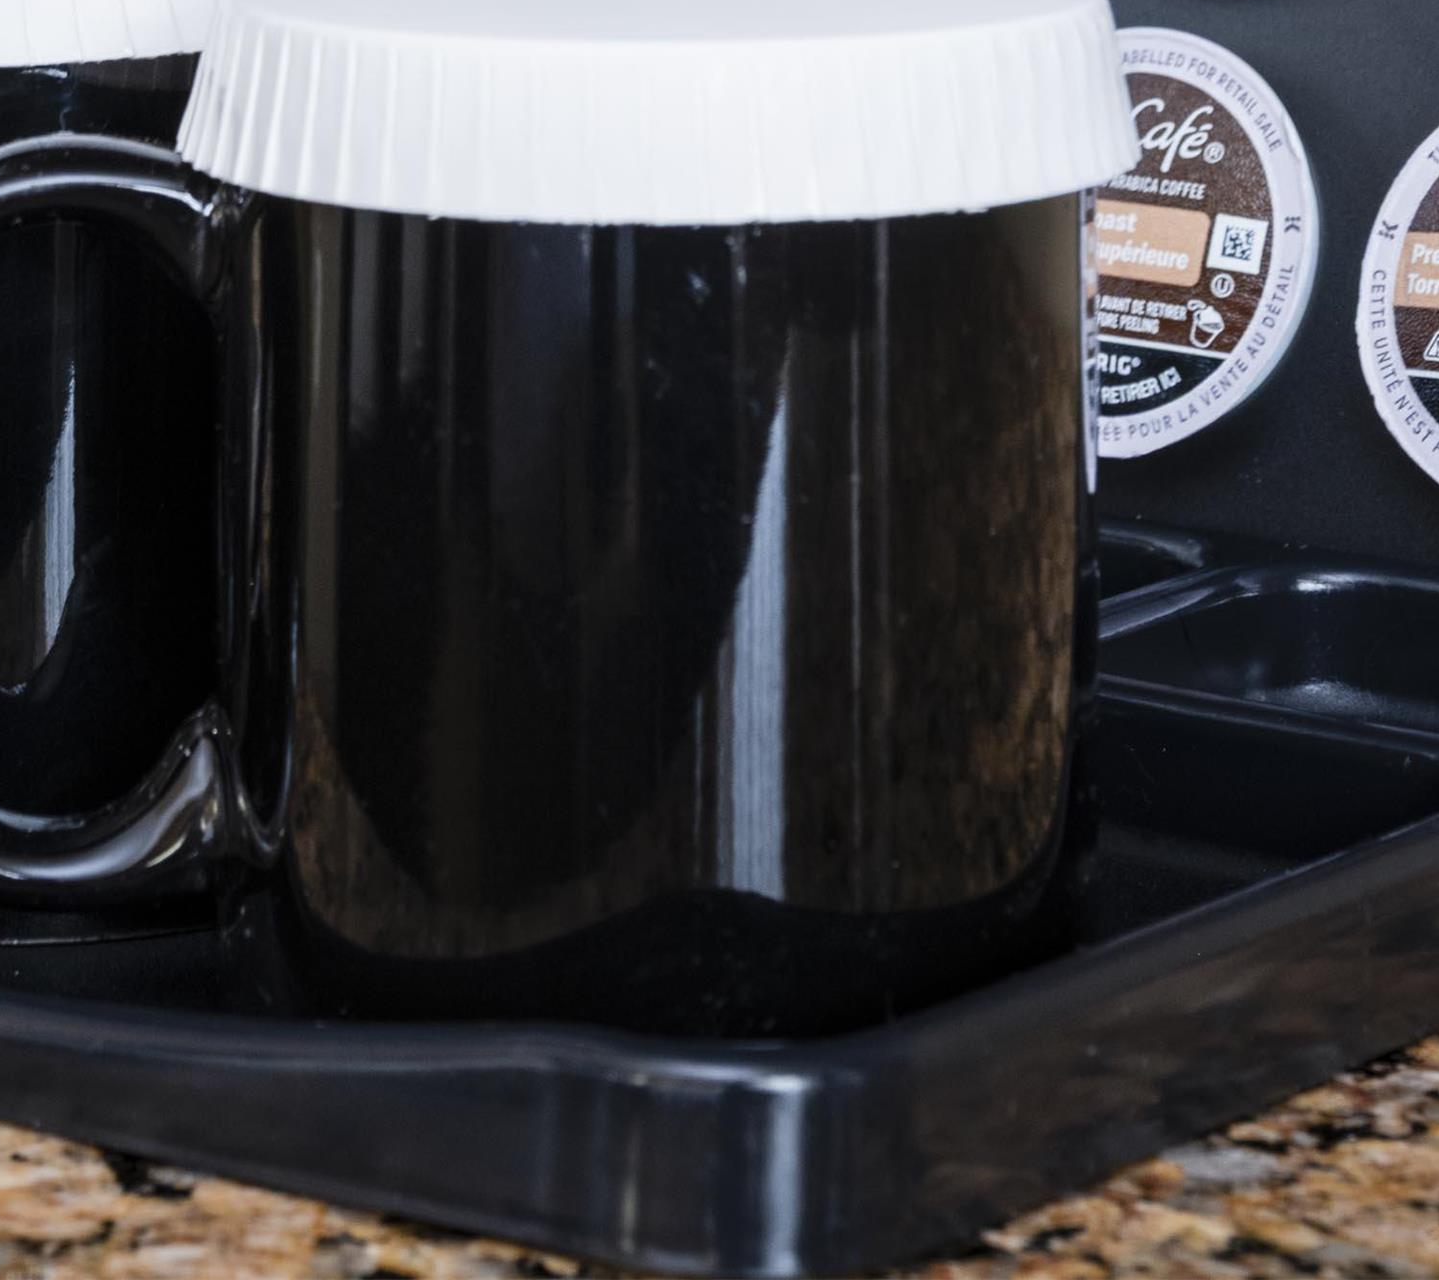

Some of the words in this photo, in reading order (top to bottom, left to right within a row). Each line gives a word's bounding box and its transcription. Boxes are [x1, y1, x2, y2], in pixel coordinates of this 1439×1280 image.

[1120, 47, 1185, 69] ABELLED
[1186, 56, 1219, 81] FOR
[1216, 72, 1260, 117] RETAIL
[1254, 114, 1285, 153] SALE
[1160, 178, 1207, 201] COFFEE
[1098, 239, 1190, 271] upérieure
[1369, 268, 1388, 330] CETTE
[1127, 414, 1174, 439] POUR
[1177, 402, 1200, 424] LA
[1199, 357, 1249, 407] VENTE
[1245, 332, 1267, 358] AU
[1261, 264, 1295, 329] DÉTAIL
[1372, 337, 1404, 394] UNITÉ
[1101, 377, 1161, 405] RETIRER
[1158, 365, 1183, 391] ICI
[1394, 394, 1434, 445] N'EST
